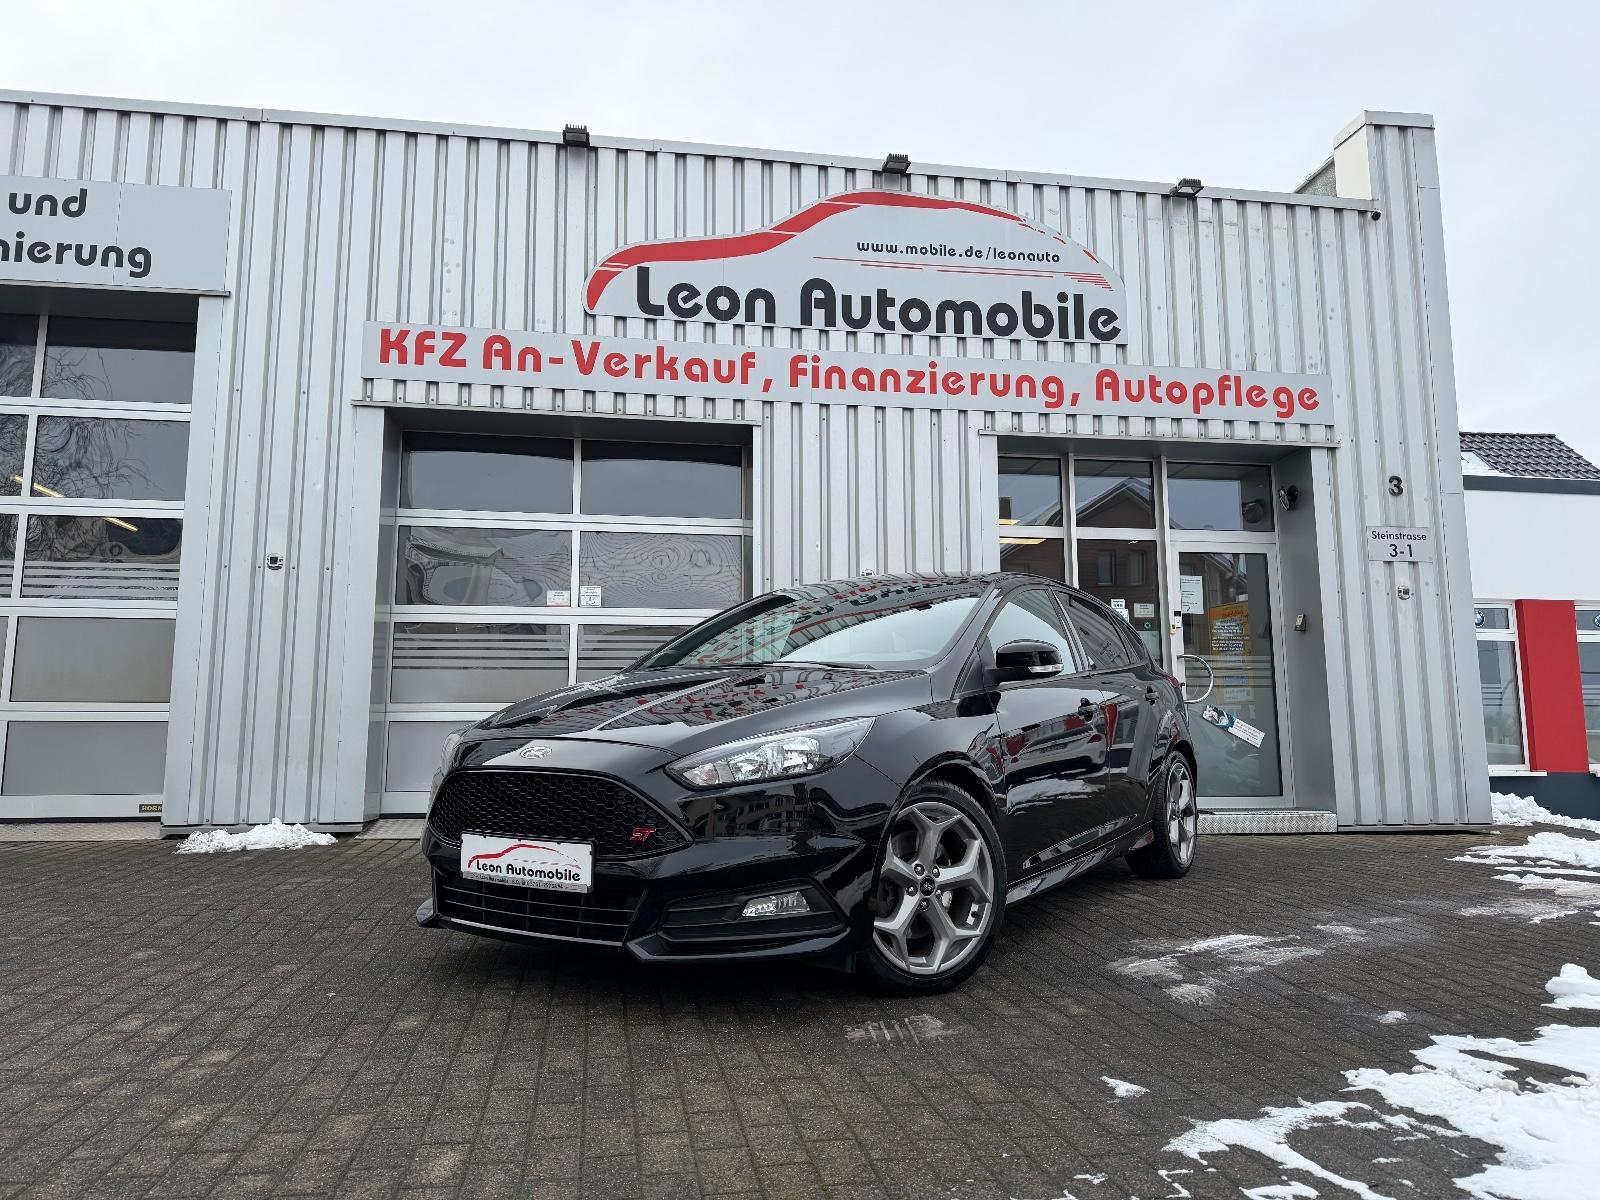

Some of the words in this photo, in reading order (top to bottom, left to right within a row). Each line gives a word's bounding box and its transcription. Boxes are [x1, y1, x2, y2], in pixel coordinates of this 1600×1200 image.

[8, 187, 88, 218] und
[856, 241, 1061, 263] www.mobile.de/leonauto
[636, 266, 776, 324] Leon
[800, 278, 1122, 342] Automobile
[483, 334, 773, 393] An-Verkauf,
[789, 354, 1081, 409] Finanzierung,
[1095, 368, 1320, 419] Autopflege
[1388, 475, 1404, 497] 3
[1371, 530, 1427, 541] Steinstrasse
[1389, 543, 1413, 558] 3-1
[476, 859, 502, 874] Leon
[506, 863, 581, 881] Automobile
